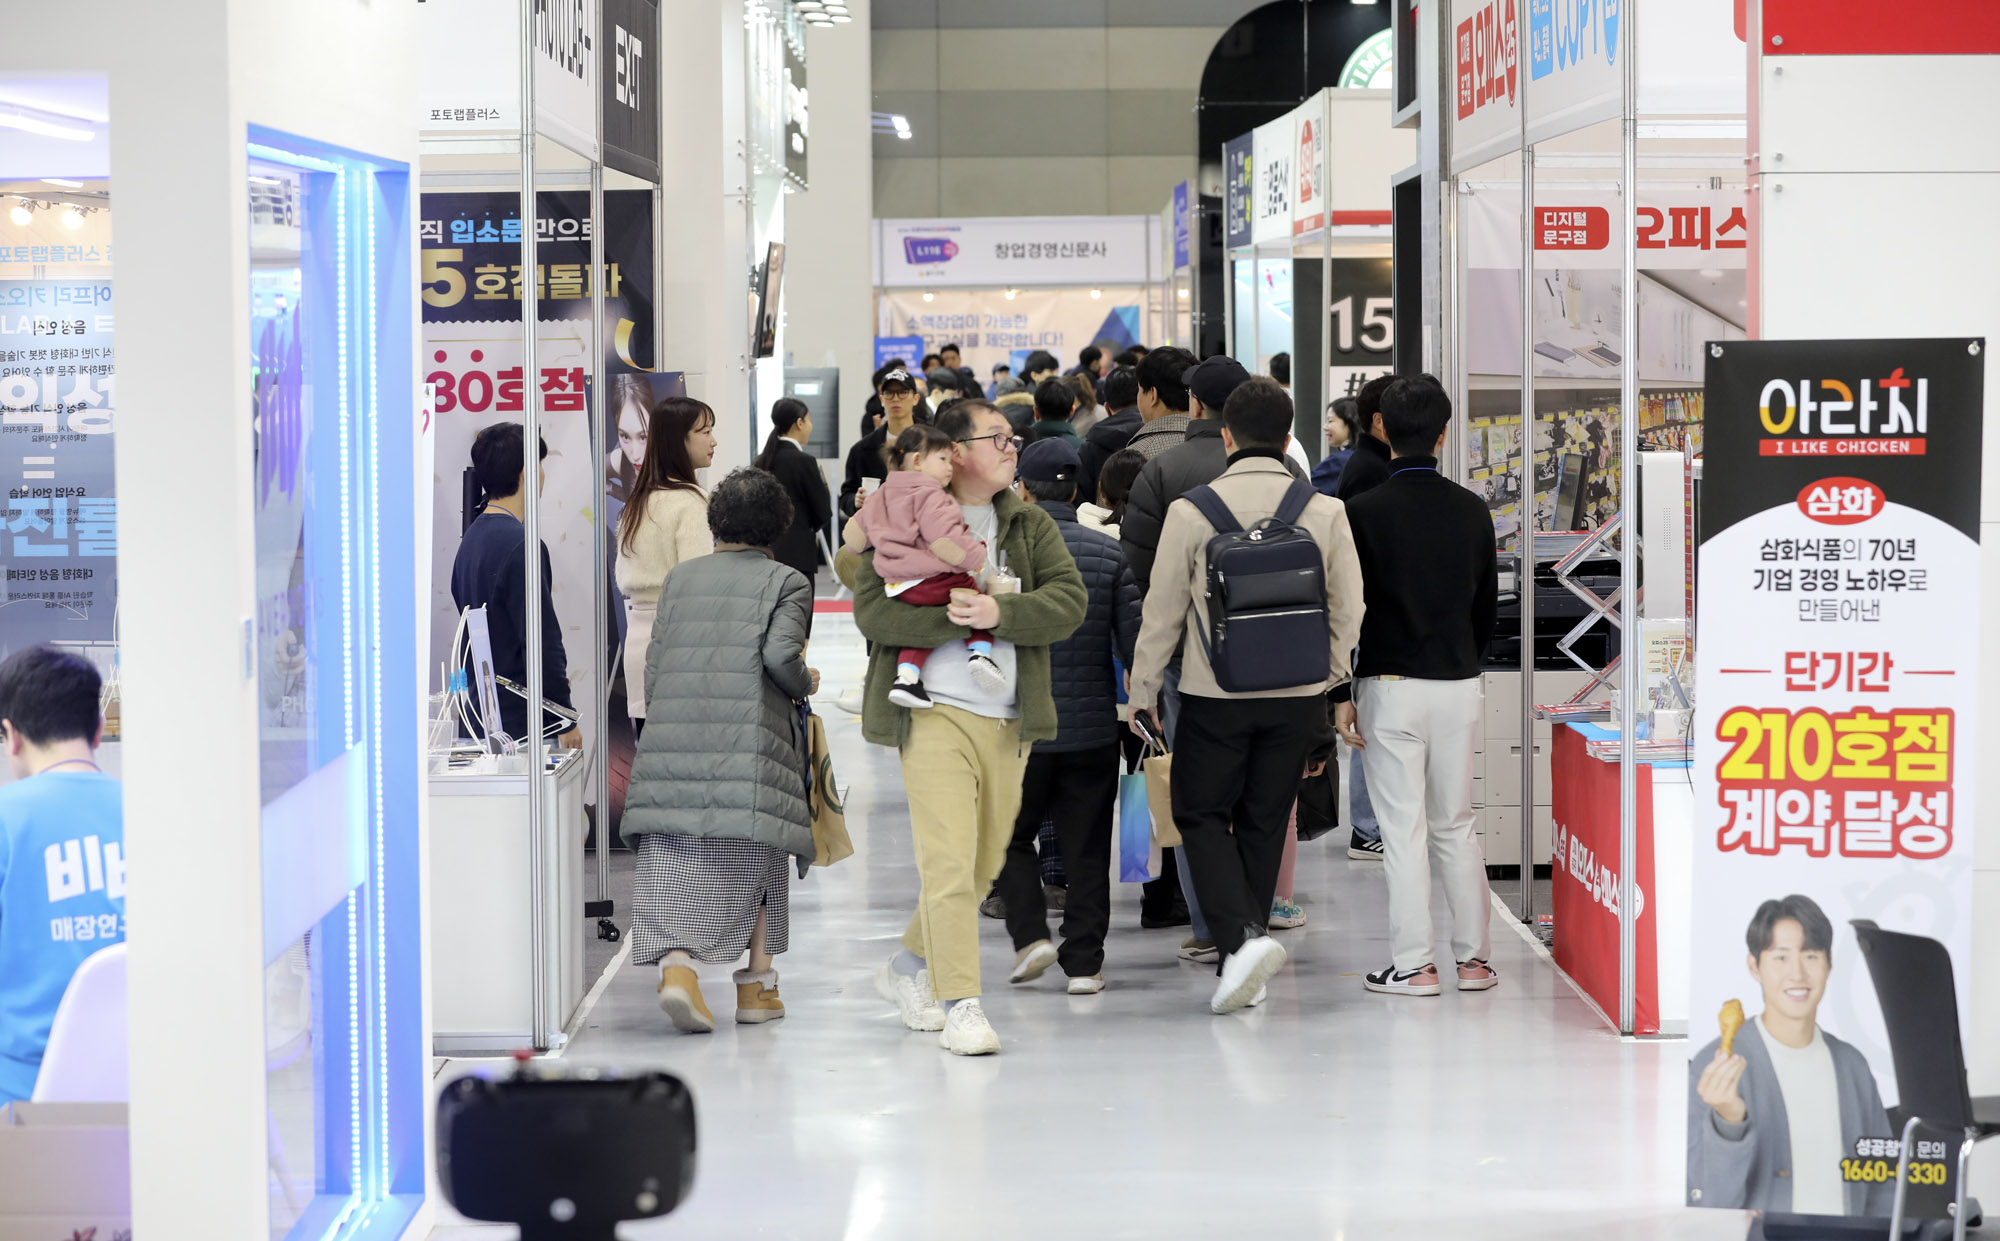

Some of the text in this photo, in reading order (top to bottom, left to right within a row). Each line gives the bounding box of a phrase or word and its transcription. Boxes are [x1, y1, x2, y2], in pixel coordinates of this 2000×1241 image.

[430, 108, 500, 121] 포토랩플러스
[1543, 212, 1587, 226] 디지털
[1636, 207, 1747, 250] 오피스
[1543, 230, 1587, 245] 문구점
[0, 245, 101, 262] 포토랩플러스
[994, 242, 1107, 259] 창업경영신문사
[474, 263, 622, 300] 호점돌파
[984, 314, 1028, 329] 가능한
[985, 332, 1064, 347] 제안합니다!
[1759, 367, 1928, 434] 아라치
[1776, 441, 1910, 454] I LIKE CHICKEN
[1806, 486, 1877, 516] 삼화
[1760, 538, 1916, 561] 삼화식품의 70년
[1754, 569, 1928, 592] 기업 경영 노하우로
[1799, 599, 1880, 622] 만들어낸
[1785, 651, 1894, 692] 단기간
[1719, 710, 1950, 783] 210호점
[1723, 788, 1949, 853] 계약 달성
[1856, 1138, 1946, 1160] 성공창 문의
[1841, 1159, 1947, 1185] 1660-330
